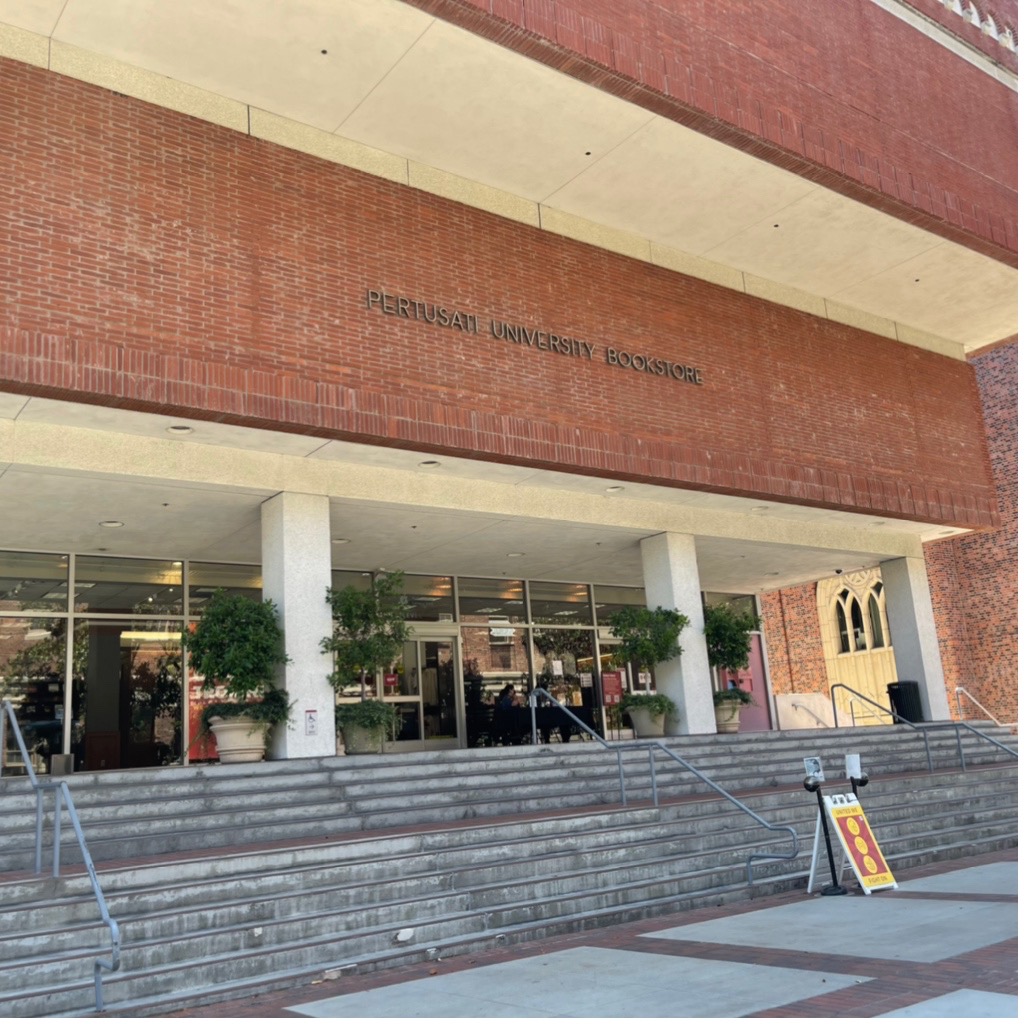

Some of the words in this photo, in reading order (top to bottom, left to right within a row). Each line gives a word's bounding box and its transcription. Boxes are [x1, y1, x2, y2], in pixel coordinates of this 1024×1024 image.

[366, 288, 479, 334] PERTUSATI
[491, 321, 596, 360] UNIVERSITY
[606, 347, 705, 386] BOOKSTORE
